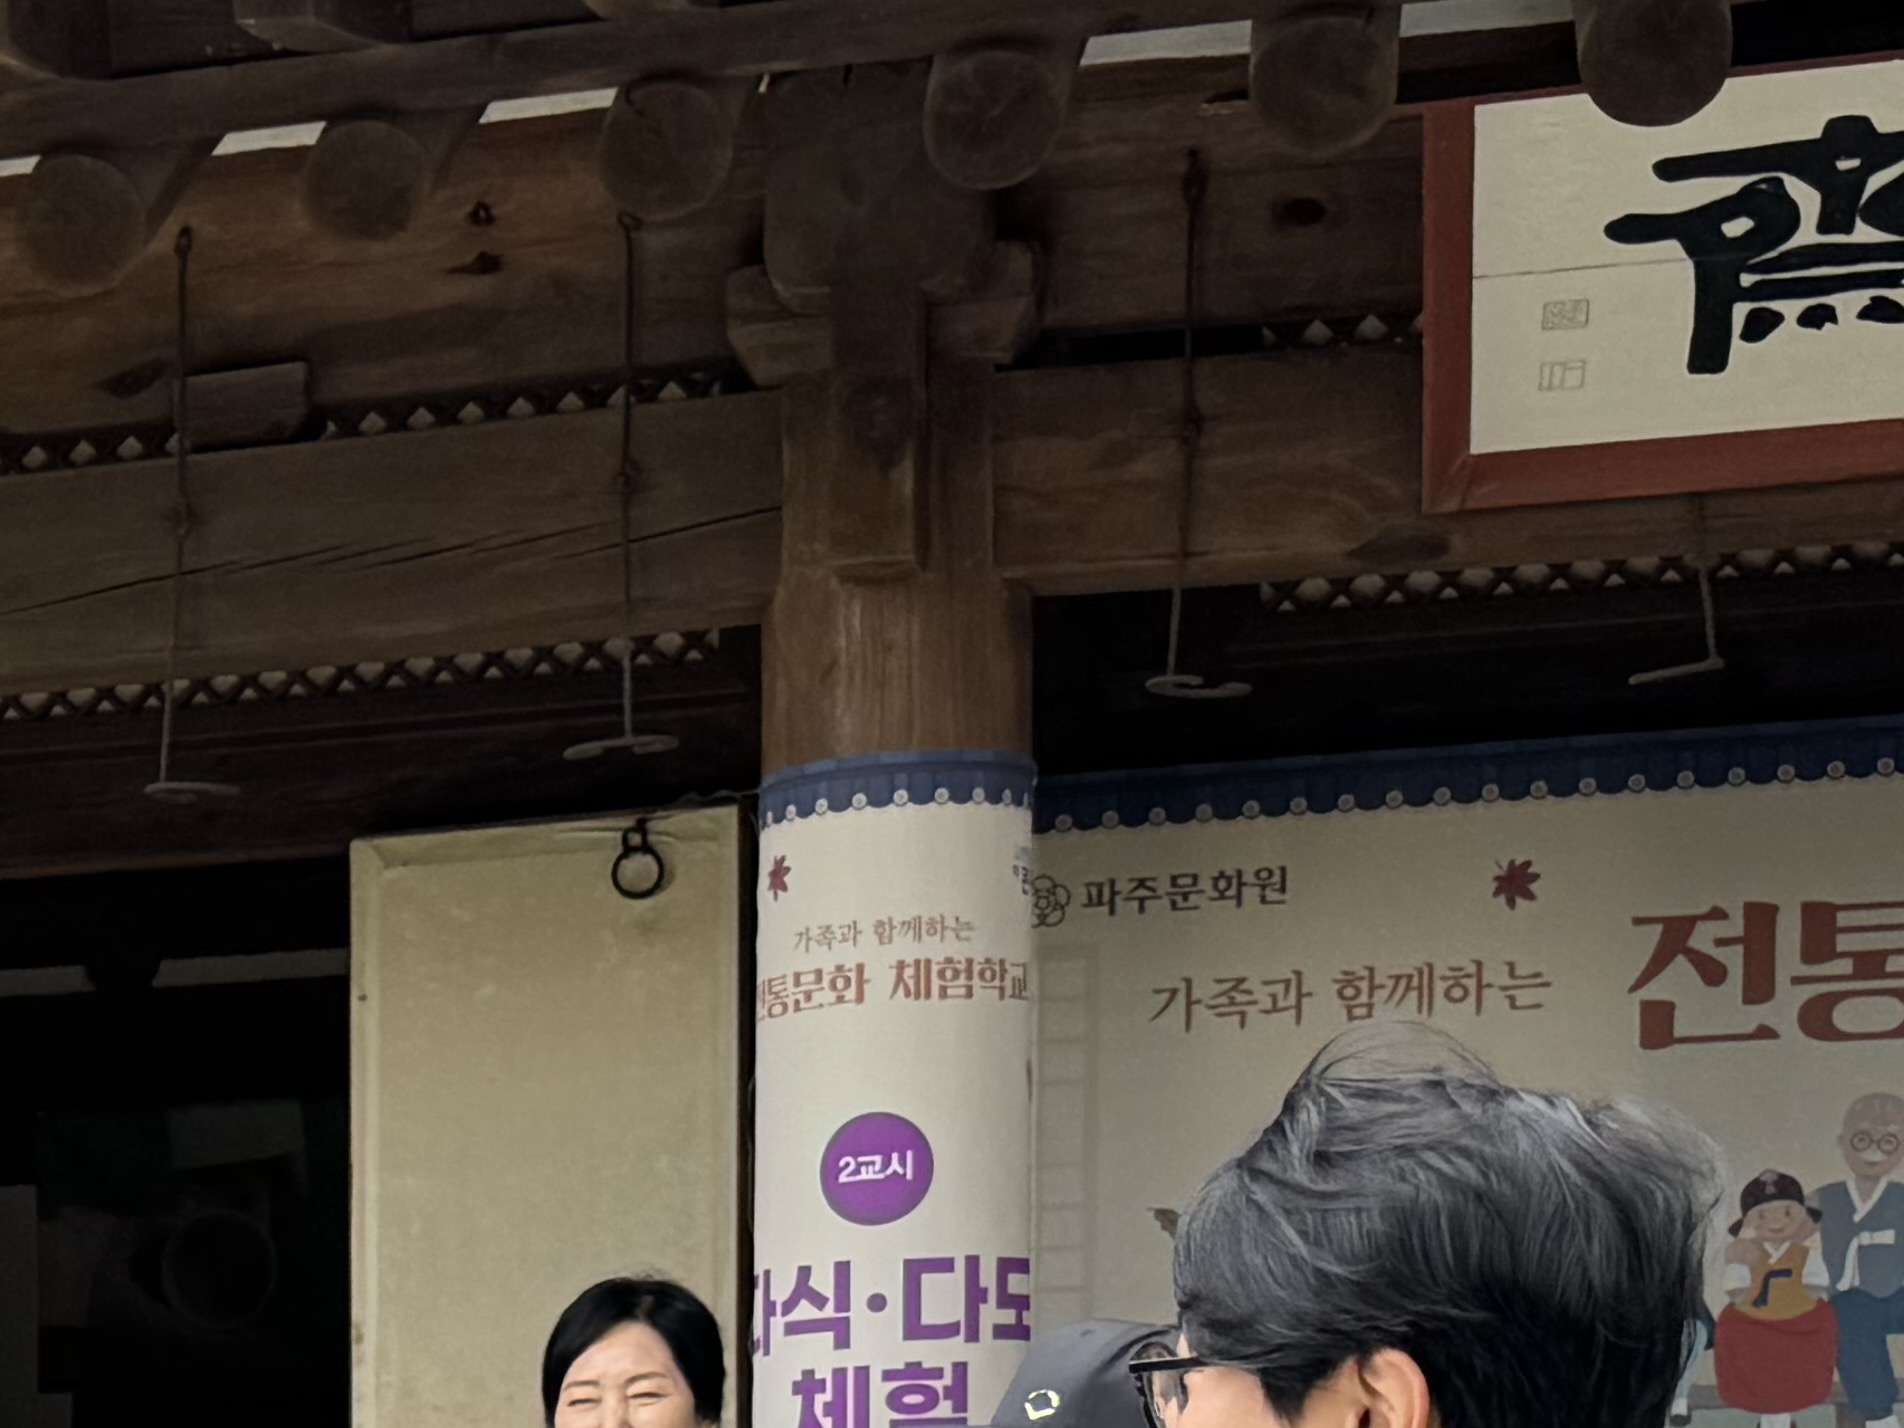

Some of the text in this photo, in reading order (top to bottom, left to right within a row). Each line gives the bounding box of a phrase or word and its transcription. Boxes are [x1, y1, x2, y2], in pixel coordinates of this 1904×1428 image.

[1081, 865, 1288, 917] 파주문화원
[794, 914, 975, 953] 가족과 함께하는
[889, 956, 1030, 1001] 체험학교
[1149, 959, 1552, 1032] 가족과 함께하는
[1627, 901, 1904, 1050] 전통
[839, 1150, 913, 1183] 2교시
